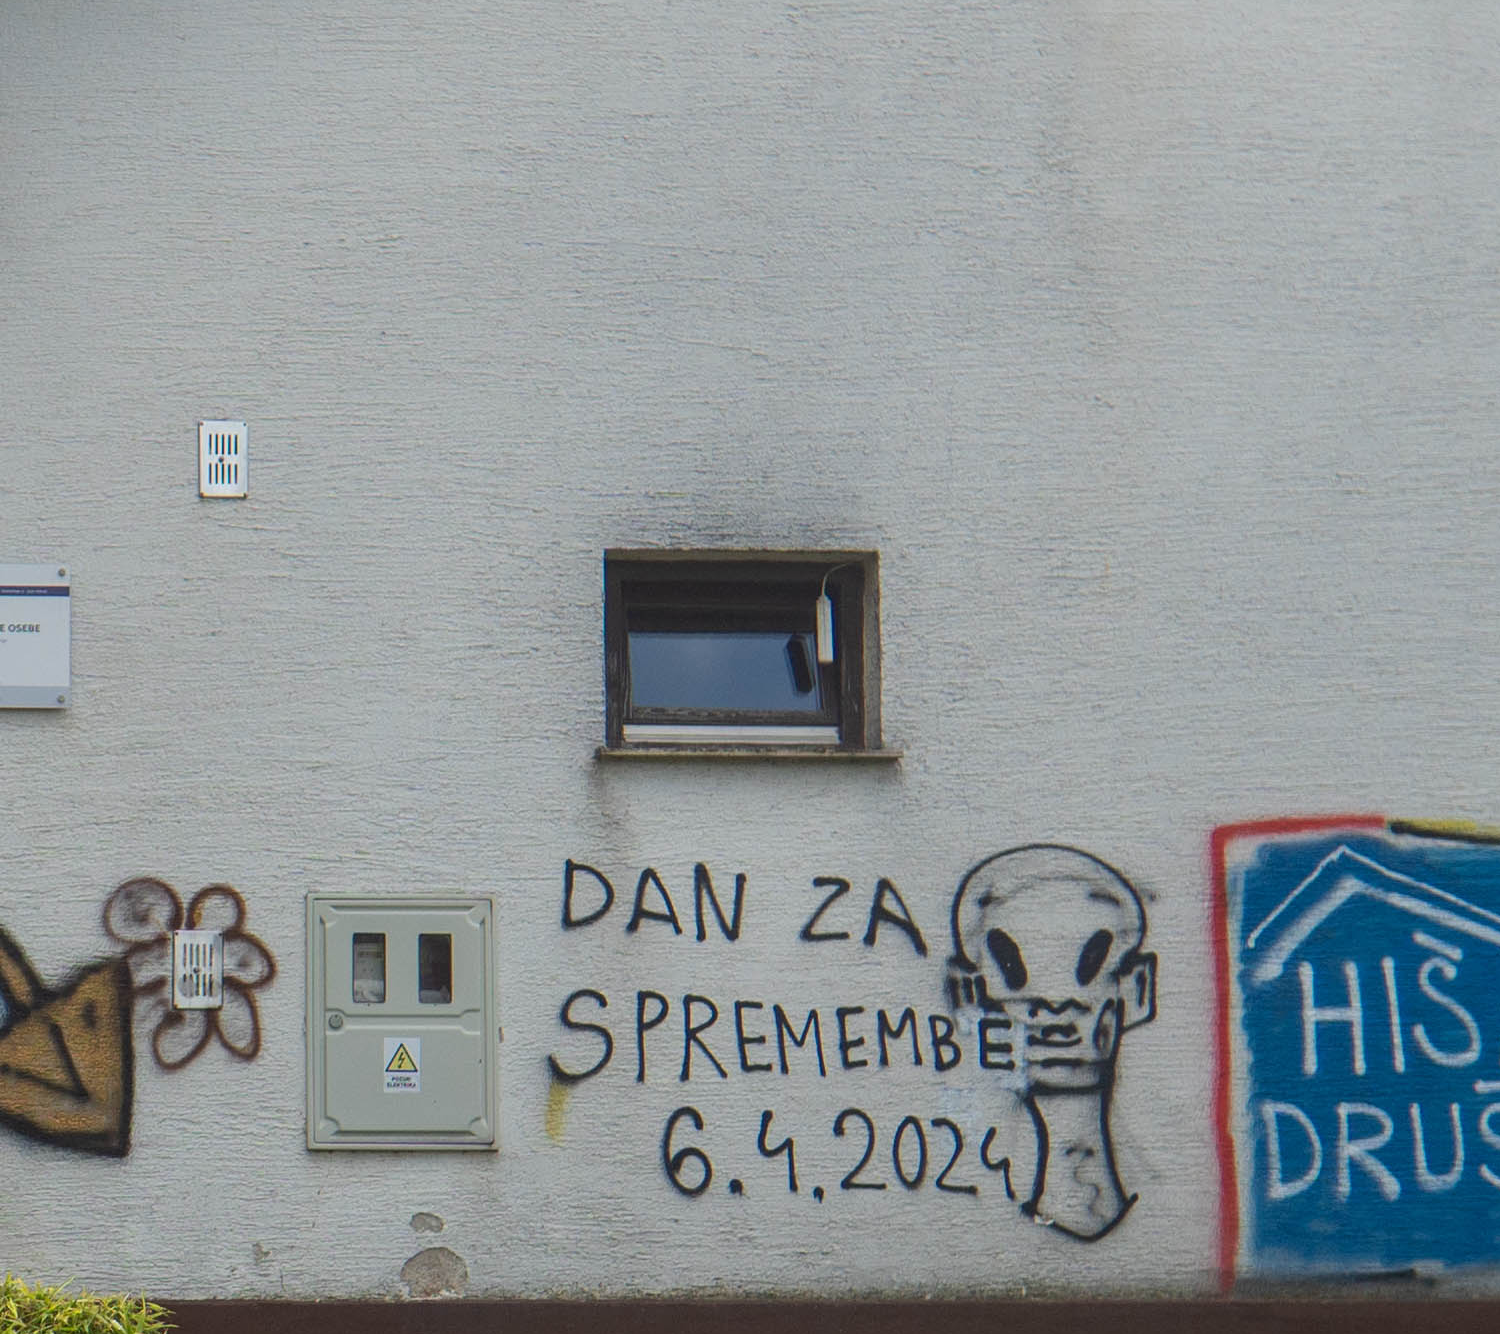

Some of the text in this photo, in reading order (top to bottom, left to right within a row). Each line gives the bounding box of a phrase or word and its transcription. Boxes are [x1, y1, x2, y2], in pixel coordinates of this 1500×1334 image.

[8, 624, 41, 634] OSEBE
[561, 858, 928, 957] DAN ZA
[547, 988, 1016, 1084] SPREMEMBE
[660, 1106, 1016, 1203] 6.4.2024
